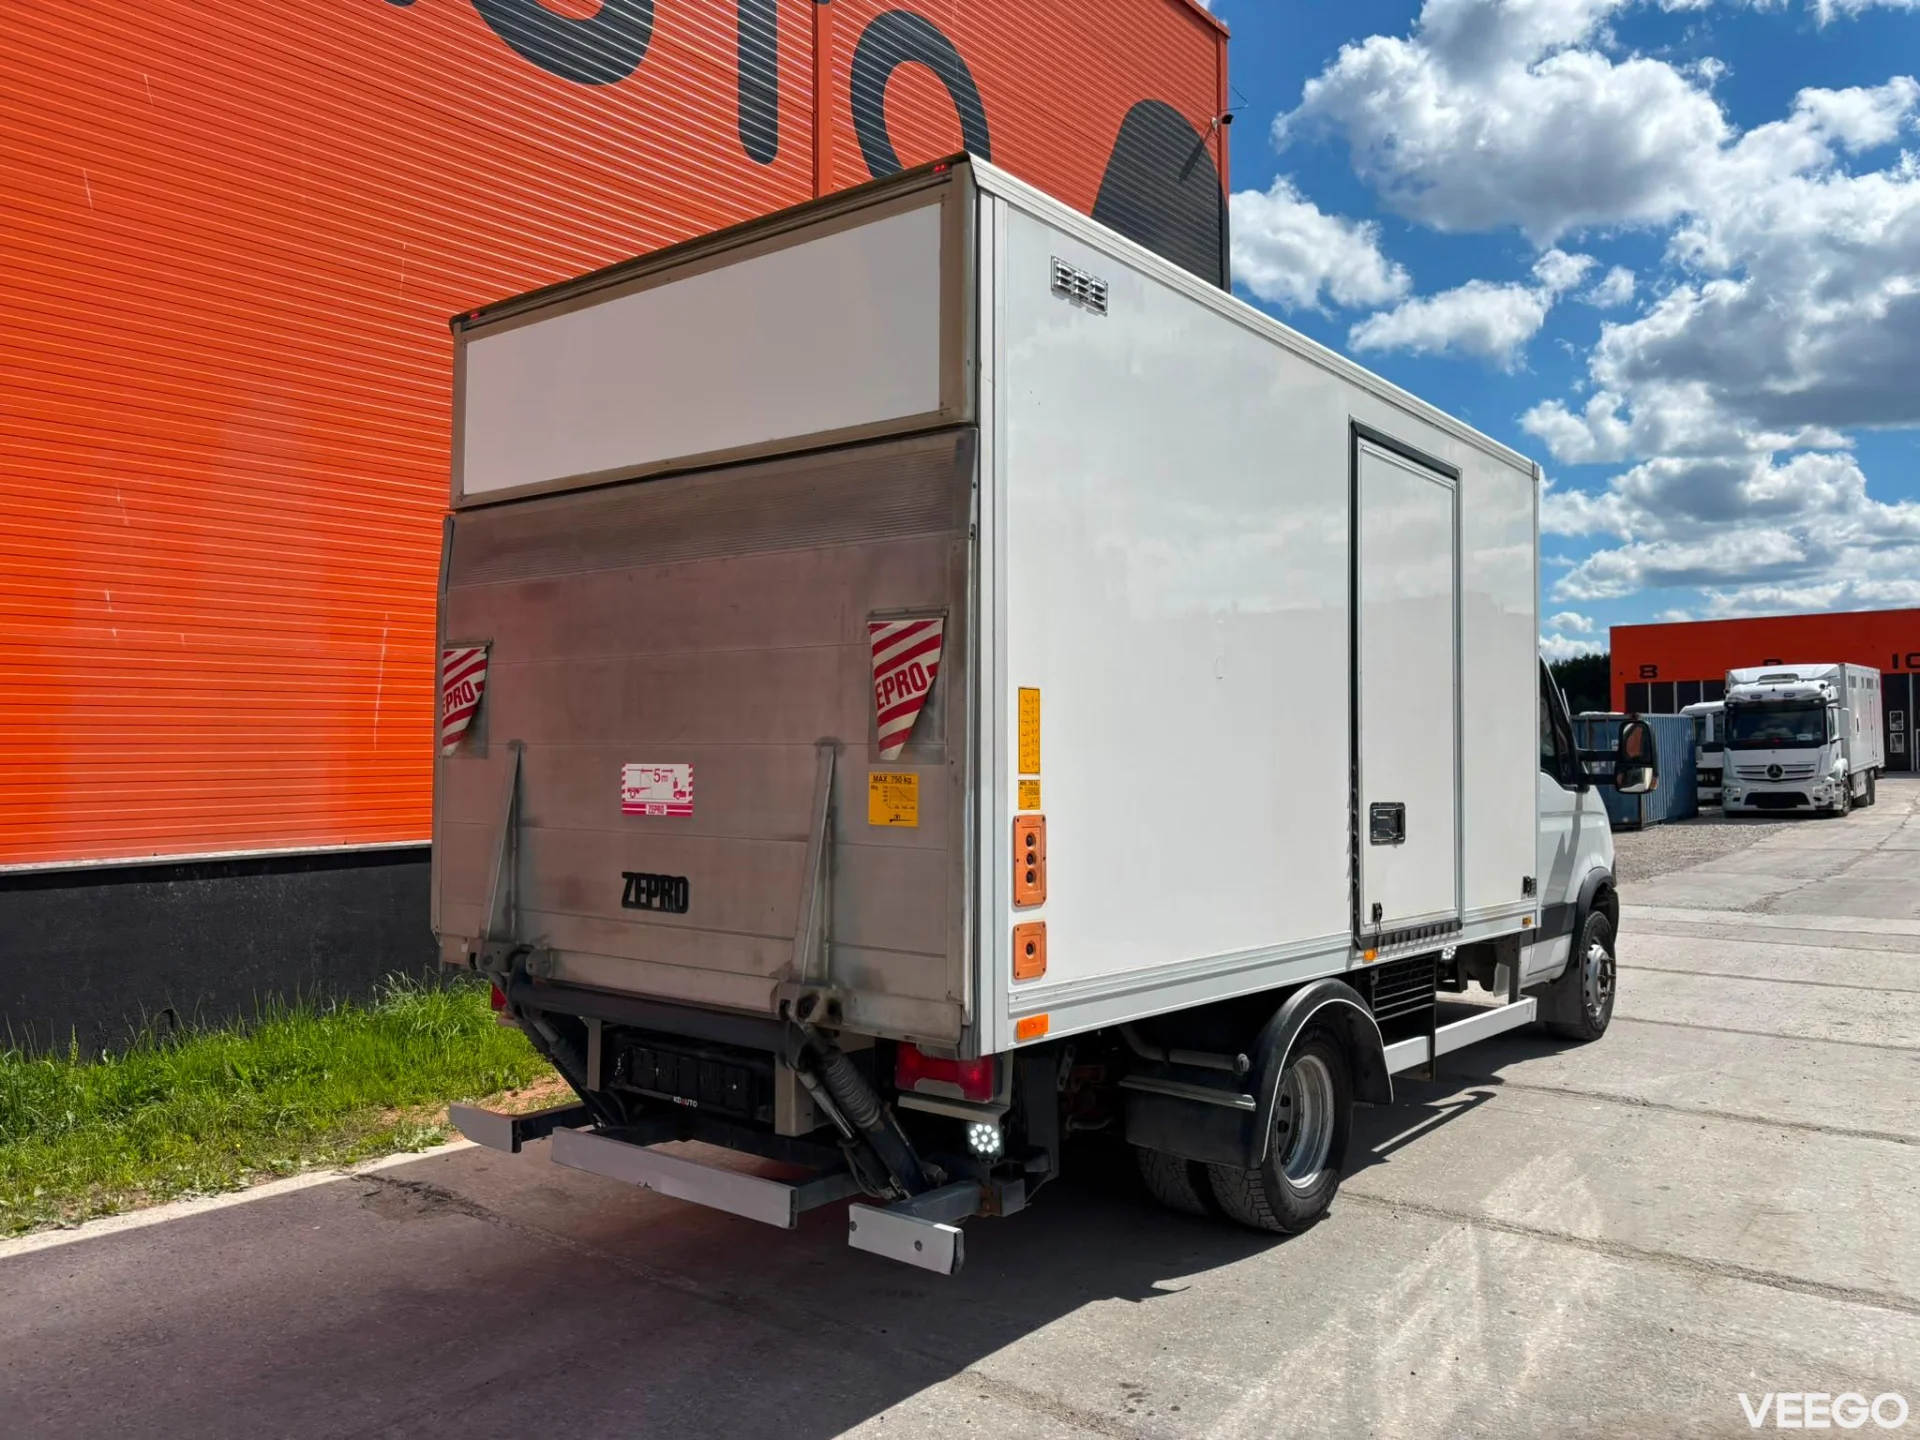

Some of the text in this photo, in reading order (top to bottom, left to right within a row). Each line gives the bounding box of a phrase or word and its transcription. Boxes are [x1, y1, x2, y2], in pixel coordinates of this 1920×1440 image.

[1639, 665, 1658, 678] 8
[872, 774, 912, 785] MAX 750 kg
[621, 871, 689, 914] ZEPRO
